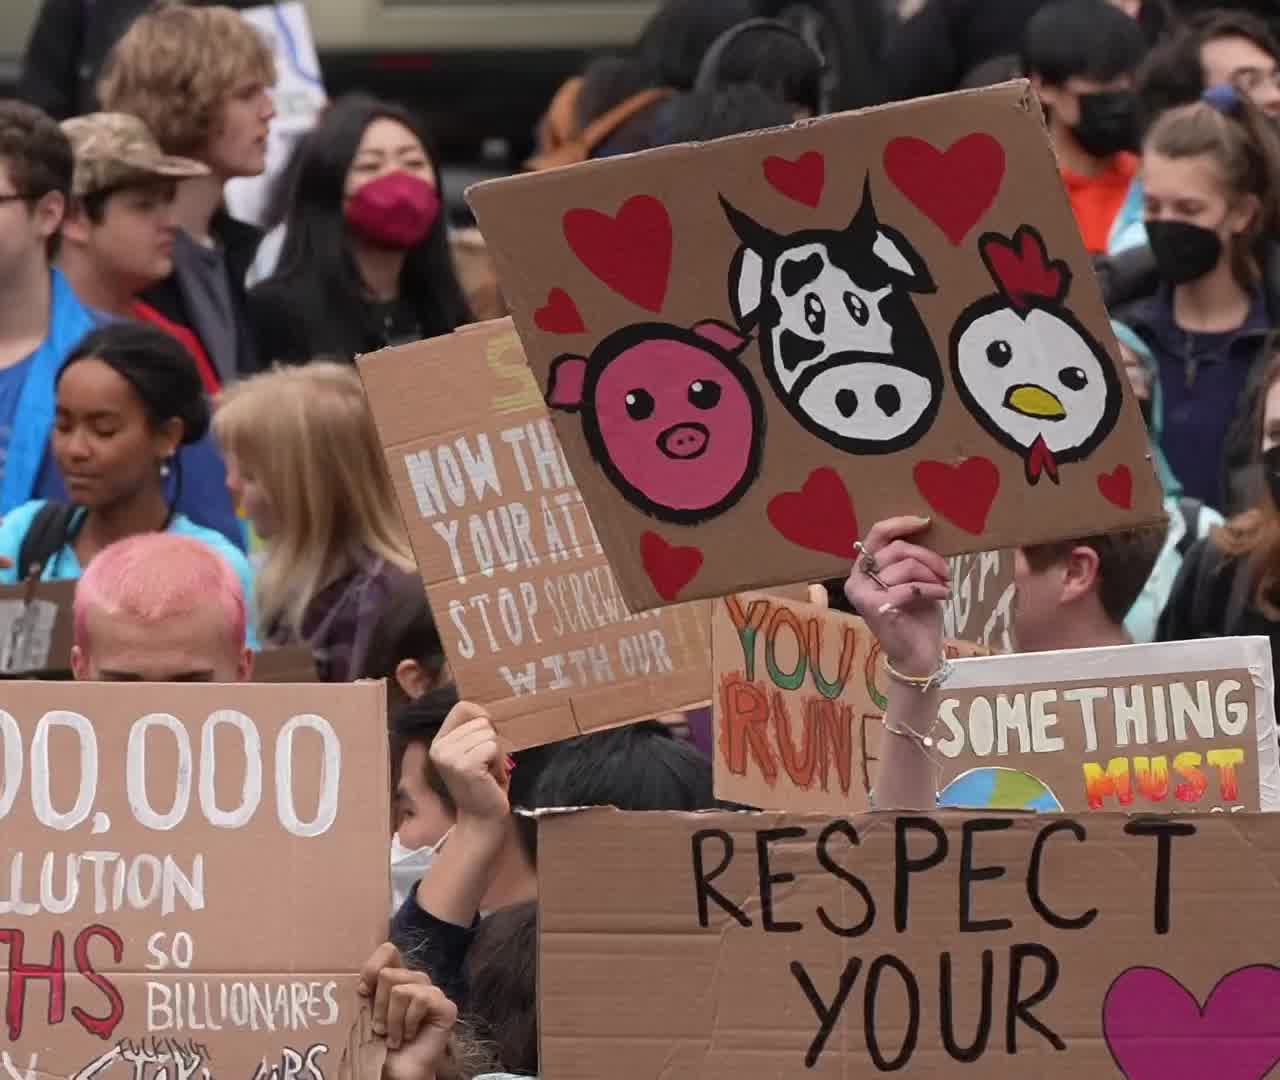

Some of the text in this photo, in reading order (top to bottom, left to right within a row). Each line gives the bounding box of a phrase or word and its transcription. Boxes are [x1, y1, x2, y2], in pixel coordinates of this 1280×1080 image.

[404, 418, 575, 518] NOW TH
[432, 503, 540, 585] YOUR
[448, 582, 541, 658] STOP
[728, 597, 856, 699] YOU
[498, 643, 616, 696] WITH
[620, 630, 673, 674] OUR
[720, 670, 853, 797] RUN
[937, 679, 1249, 758] SOMETHING
[1082, 748, 1245, 809] MUST
[692, 816, 1197, 938] RESPECT
[146, 931, 193, 971] SO
[146, 980, 340, 1033] BILLIONARES
[790, 943, 1067, 1073] YOUR
